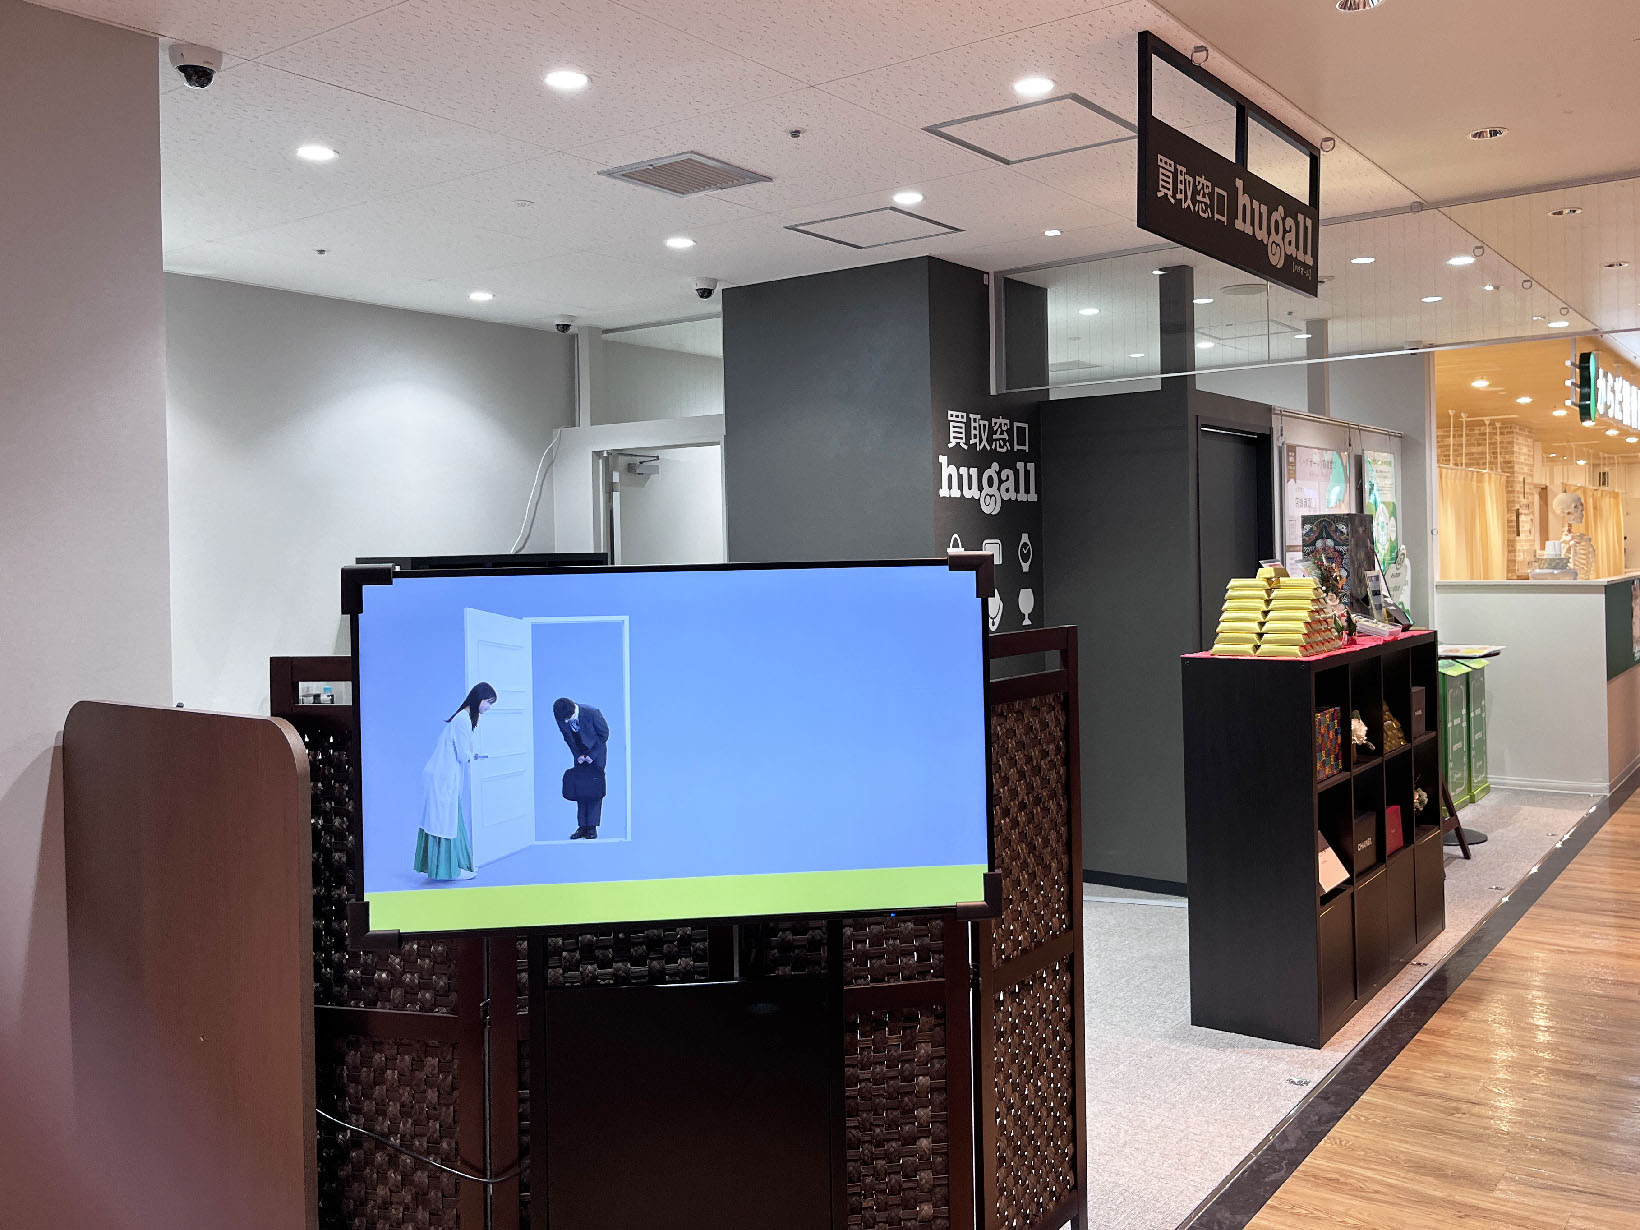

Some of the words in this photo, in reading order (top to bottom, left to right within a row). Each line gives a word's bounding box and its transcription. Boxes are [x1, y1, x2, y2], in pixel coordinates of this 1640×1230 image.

[1157, 153, 1228, 226] 買取窓口
[1234, 178, 1313, 268] hugall
[947, 410, 1029, 452] 買取窓口
[938, 455, 1038, 515] hugall
